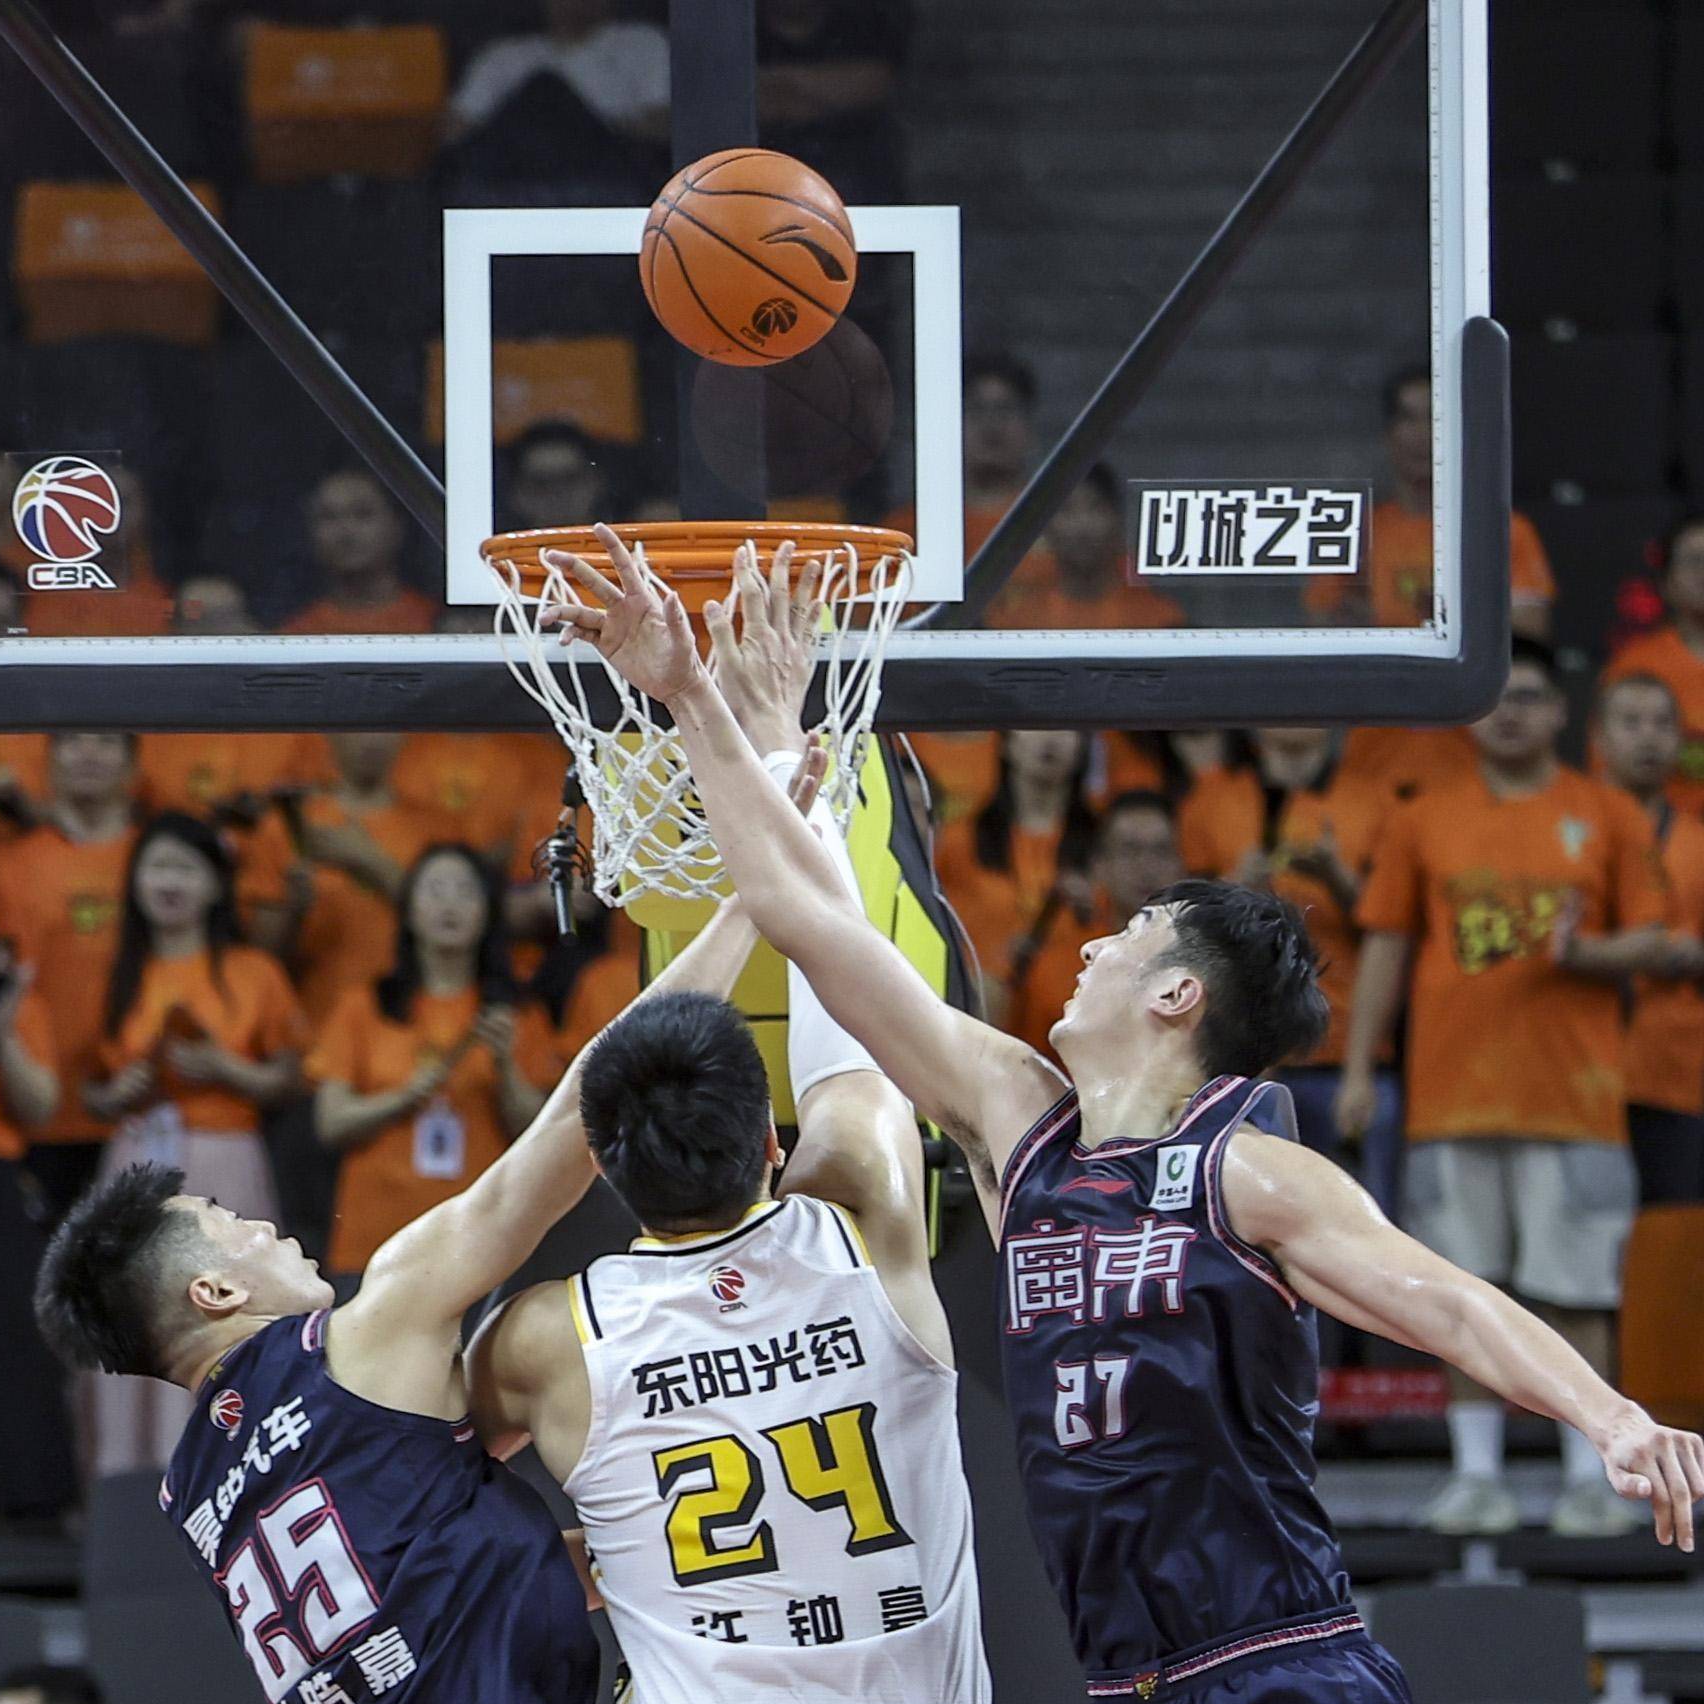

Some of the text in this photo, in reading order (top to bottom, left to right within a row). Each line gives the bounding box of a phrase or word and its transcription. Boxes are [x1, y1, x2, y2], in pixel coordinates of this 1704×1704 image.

[28, 562, 118, 590] CBA
[1141, 488, 1360, 572] 以城之名
[632, 1316, 867, 1419] 东阳光药
[1053, 1354, 1133, 1449] 27
[652, 1401, 916, 1588] 24
